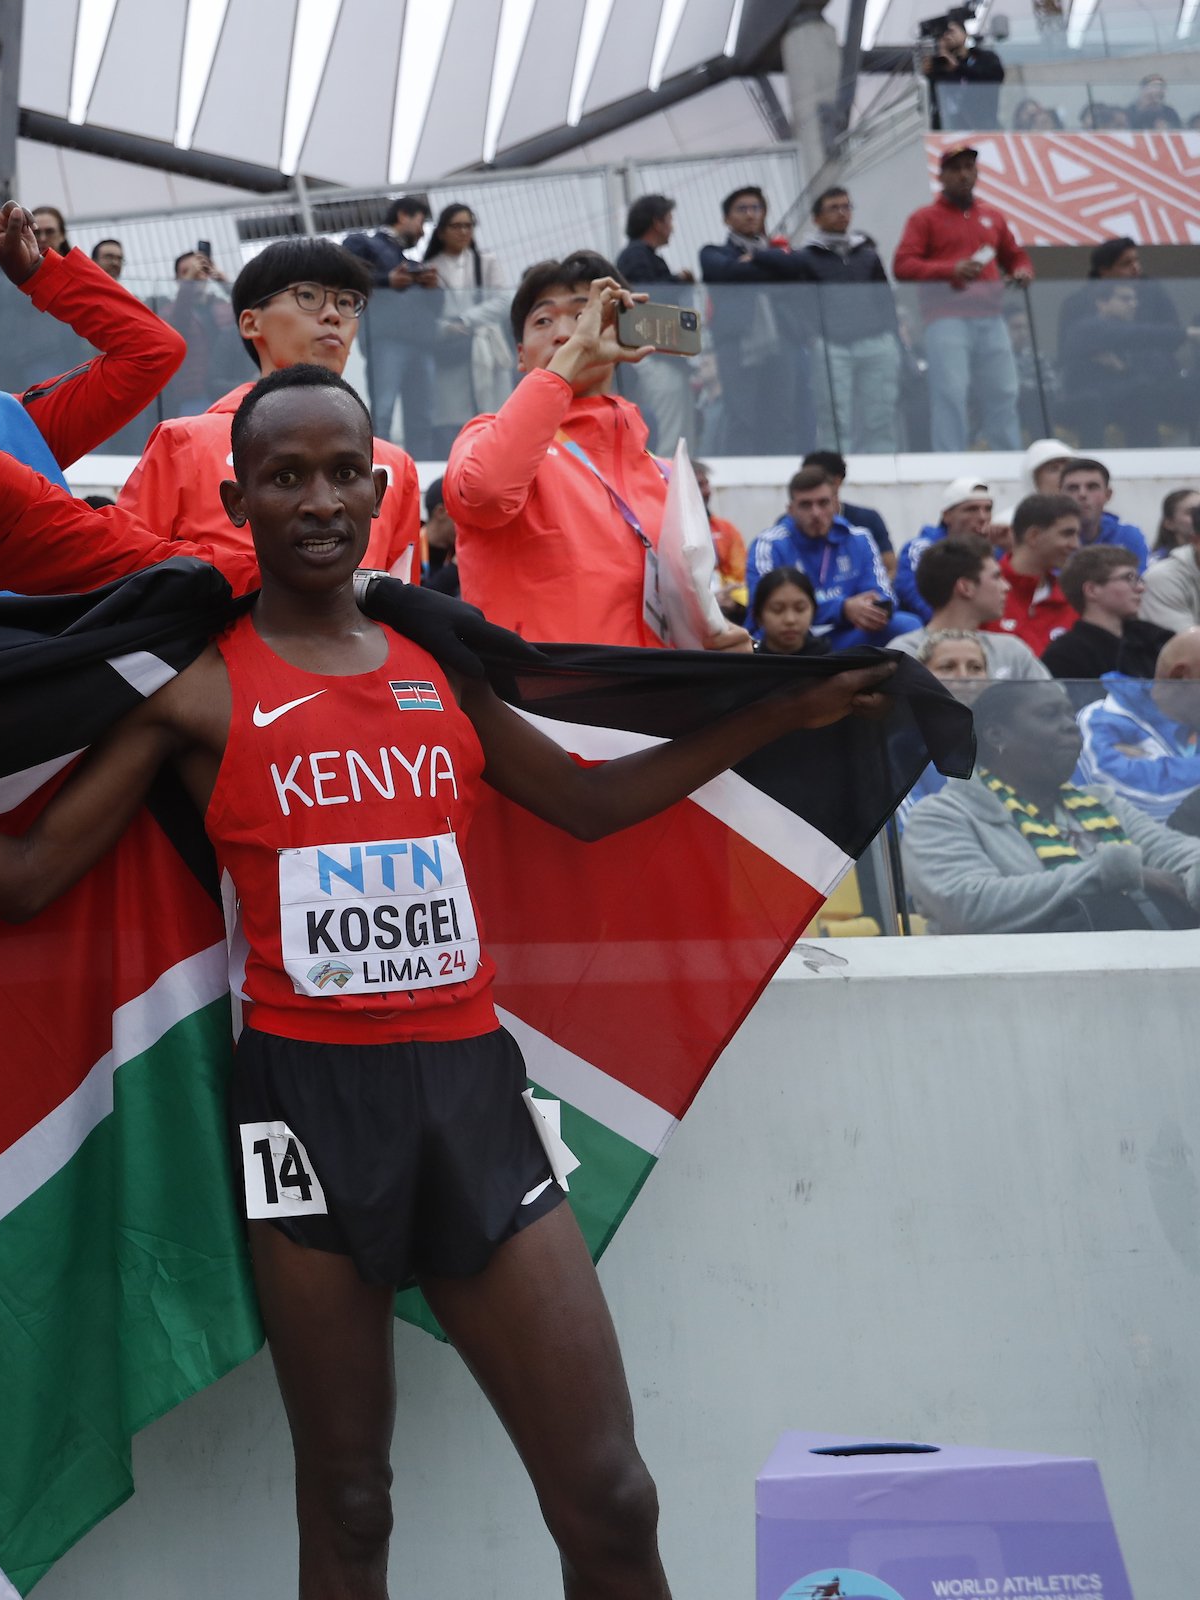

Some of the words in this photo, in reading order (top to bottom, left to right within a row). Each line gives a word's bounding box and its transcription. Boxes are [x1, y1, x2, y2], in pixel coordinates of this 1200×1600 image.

[270, 745, 458, 816] KENYA
[317, 839, 443, 896] NTN
[306, 898, 461, 955] KOSGEI
[363, 957, 432, 984] LIMA
[437, 950, 466, 976] 24
[253, 1138, 312, 1204] 14
[932, 1577, 998, 1596] WORLD
[1002, 1574, 1103, 1593] ATHLETICS
